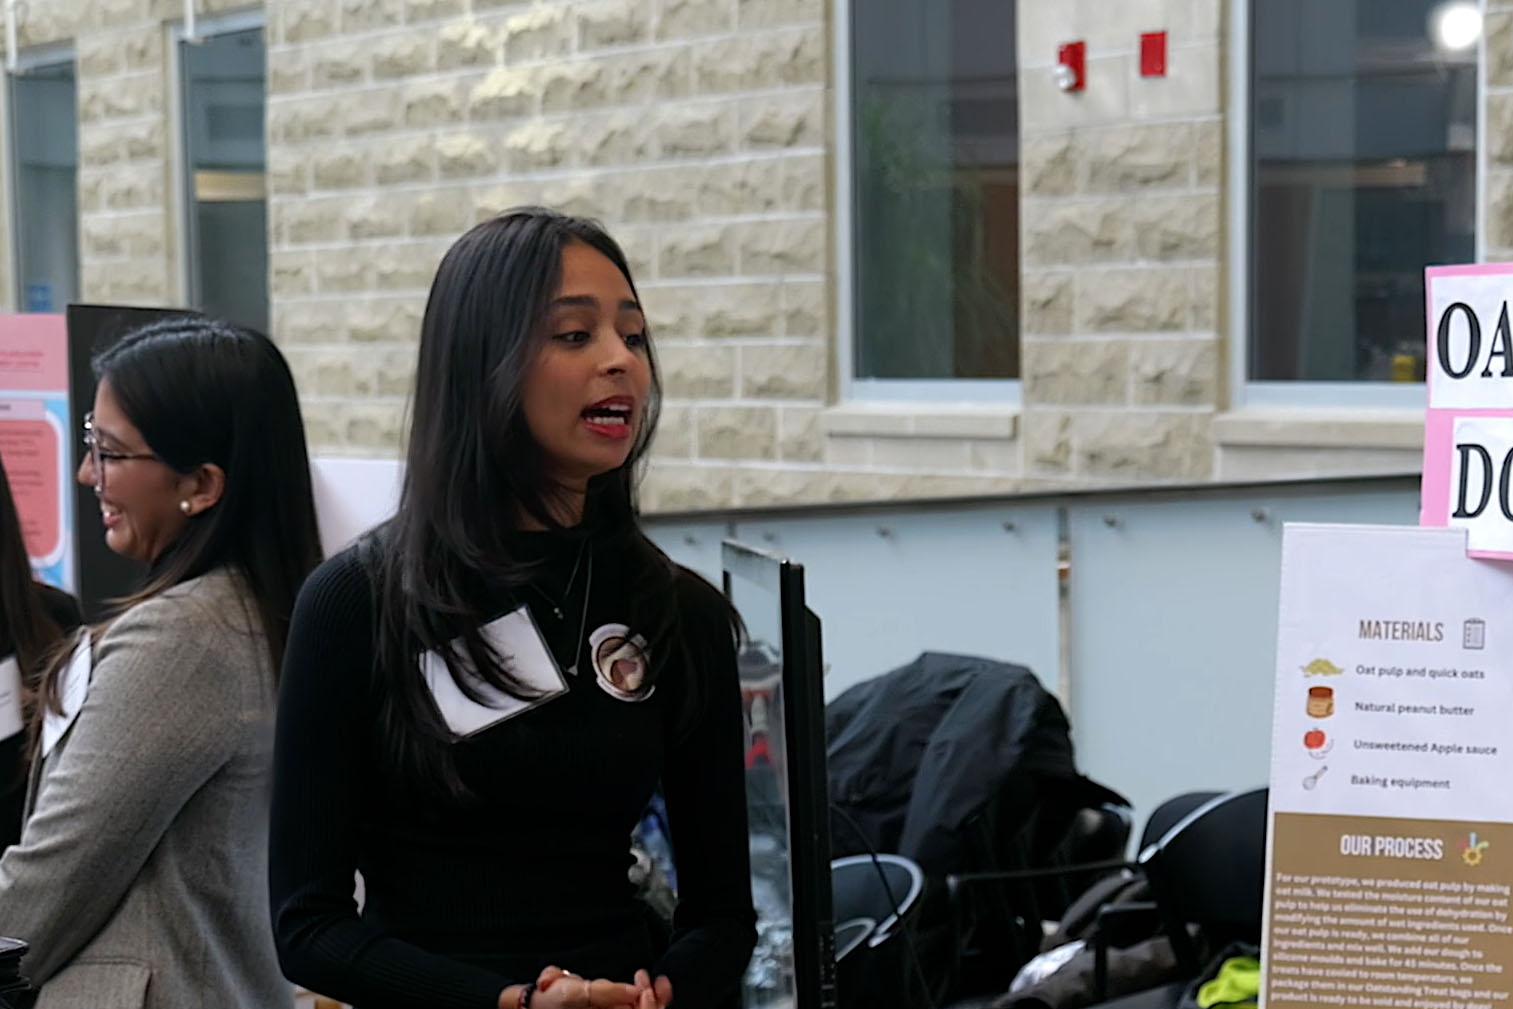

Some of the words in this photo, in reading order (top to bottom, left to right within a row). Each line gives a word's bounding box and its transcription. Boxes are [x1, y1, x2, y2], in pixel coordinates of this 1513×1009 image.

[1358, 618, 1443, 642] MATERIALS
[1355, 664, 1376, 675] Oat
[1377, 665, 1403, 678] pulp
[1405, 666, 1426, 677] and
[1428, 667, 1458, 679] quick
[1460, 669, 1485, 679] oats
[1354, 701, 1396, 713] Natural
[1397, 703, 1437, 716] peanut
[1438, 704, 1474, 716] butter
[1353, 739, 1428, 752] Unsweetened
[1430, 742, 1463, 755] Apple
[1465, 745, 1497, 755] sauce
[1350, 774, 1388, 788] Baking
[1390, 777, 1450, 790] equipment
[1339, 833, 1371, 856] OUR
[1374, 835, 1443, 860] PROCESS
